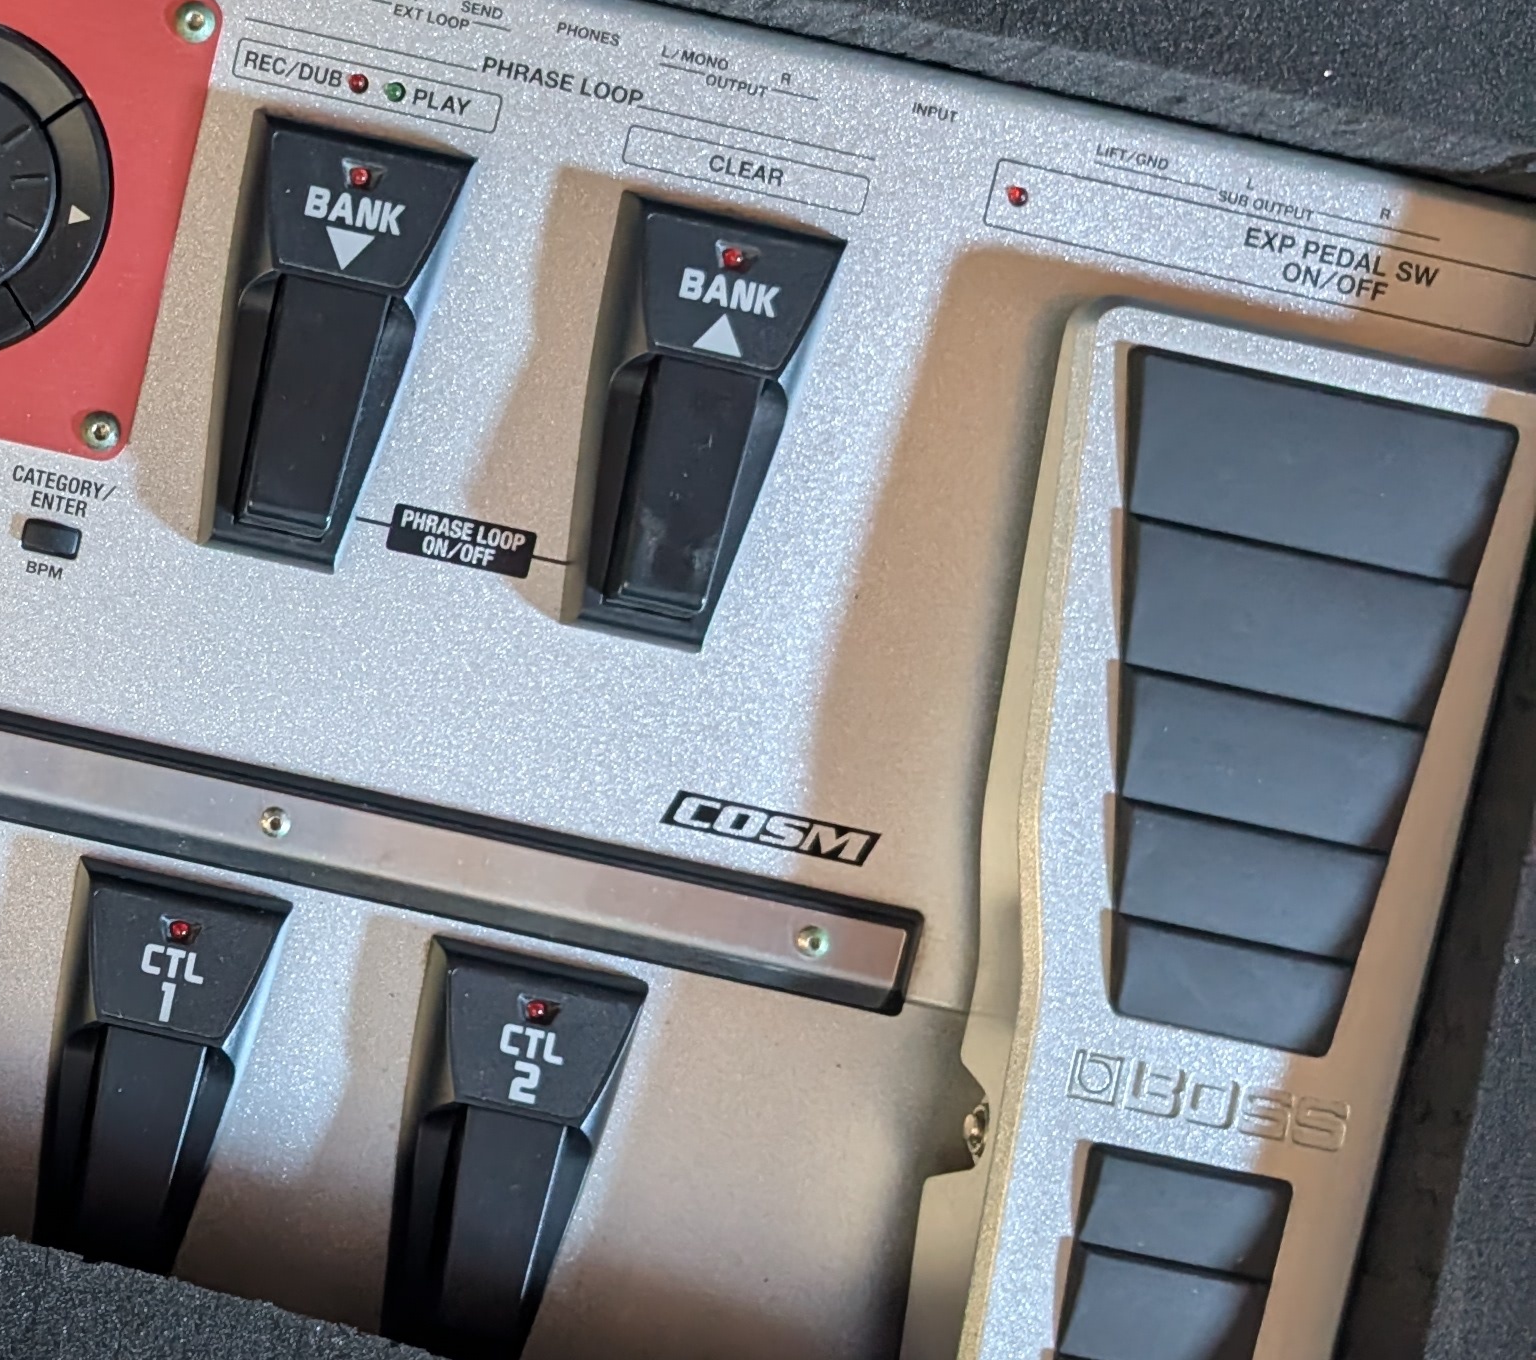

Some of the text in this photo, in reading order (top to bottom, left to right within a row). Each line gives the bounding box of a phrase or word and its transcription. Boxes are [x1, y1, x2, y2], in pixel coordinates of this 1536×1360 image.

[393, 4, 470, 31] EXT LOOP
[460, 0, 503, 20] SEND
[557, 22, 621, 47] PHONES
[244, 51, 343, 88] REC/DUB
[661, 45, 730, 71] L/MONO
[482, 56, 644, 107] PHRASE LOOP
[705, 73, 768, 98] OUTPUT
[780, 72, 792, 86] R
[412, 89, 471, 117] PLAY
[912, 101, 959, 124] INPUT
[709, 155, 785, 187] CLEAR
[1095, 144, 1170, 170] LIFT/GND
[1246, 177, 1255, 190] L
[304, 185, 406, 236] BANK
[1218, 189, 1315, 222] SUB OUTPUT
[1380, 207, 1393, 221] R
[1244, 227, 1440, 289] EXP PEDAL SW
[678, 267, 782, 318] BANK
[1282, 263, 1389, 302] ON/OFF
[12, 464, 117, 501] CATEGORY/
[30, 490, 88, 518] ENTER
[400, 509, 526, 552] PHRASE LOOP
[422, 534, 496, 568] ON/OFF
[25, 560, 64, 580] BPM
[672, 794, 868, 863] COSM
[141, 943, 204, 985] CTL
[158, 981, 175, 1023] 1
[500, 1023, 563, 1066] CTL
[507, 1060, 540, 1105] 2
[1124, 1060, 1351, 1152] BOSS
